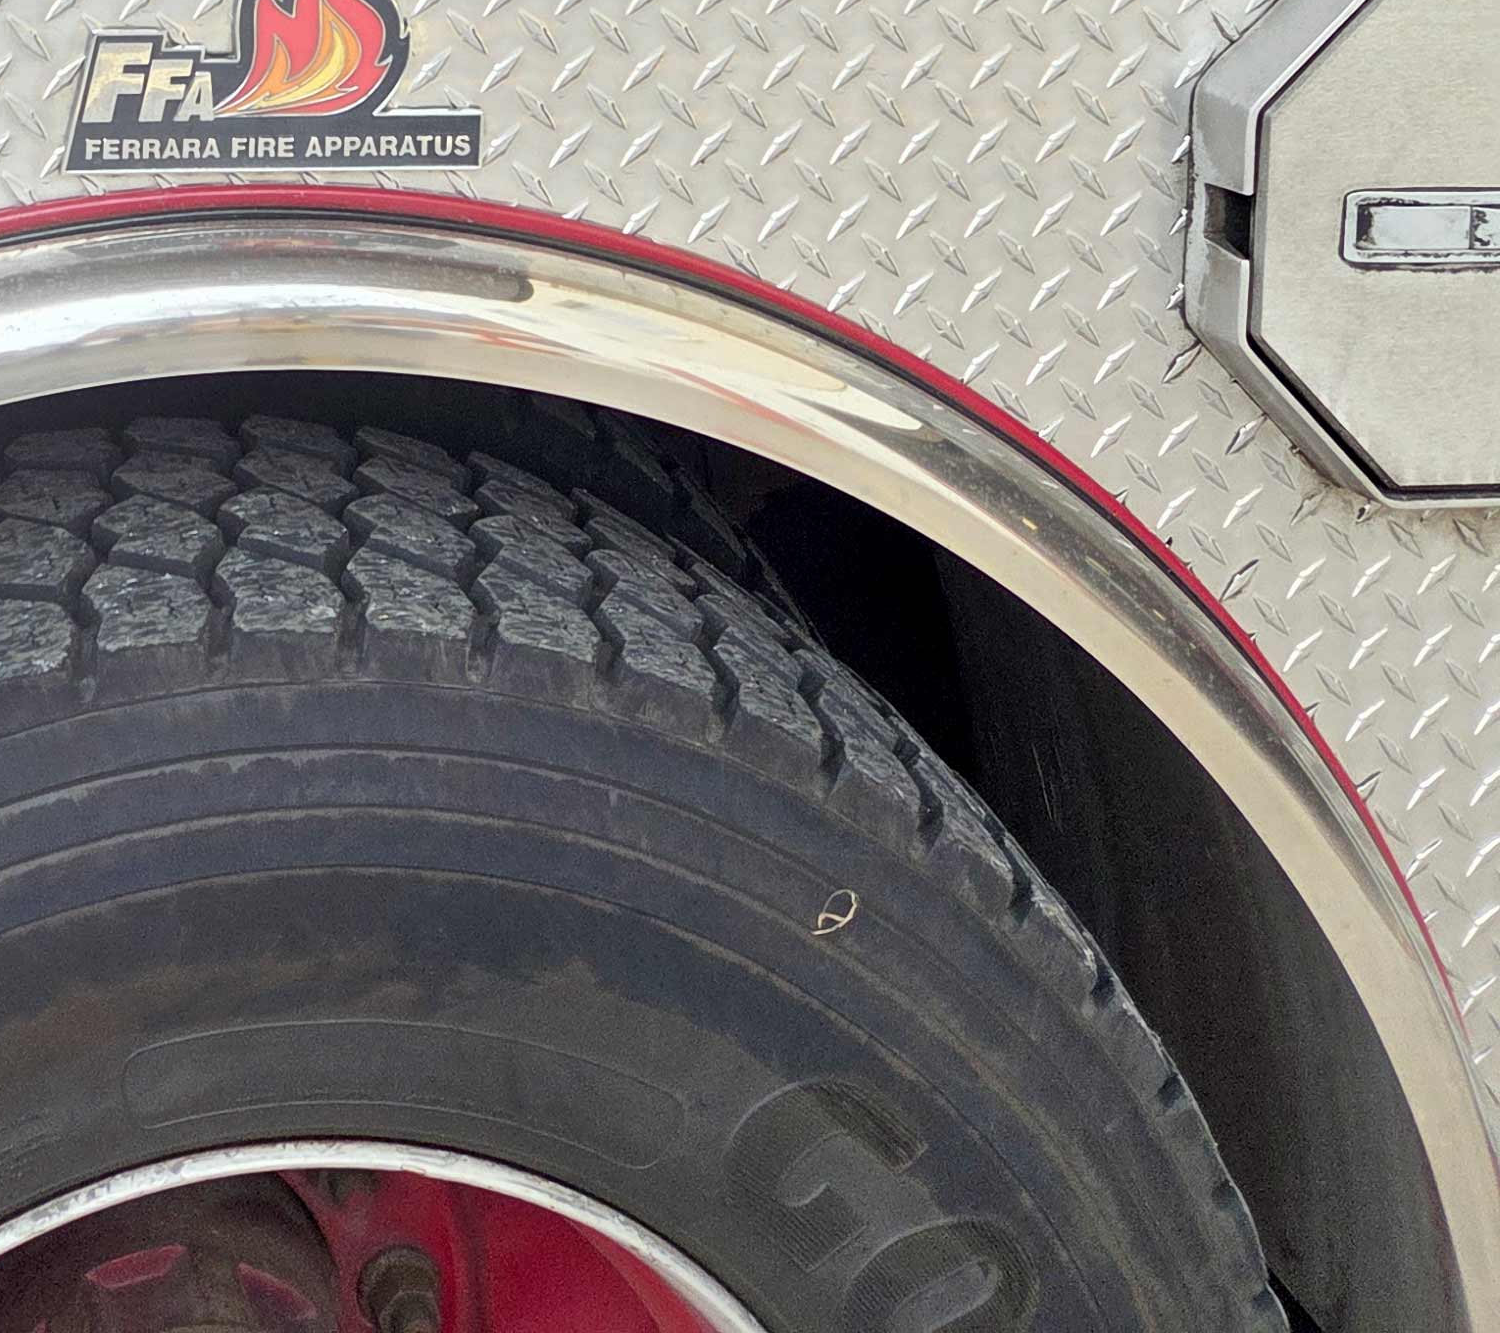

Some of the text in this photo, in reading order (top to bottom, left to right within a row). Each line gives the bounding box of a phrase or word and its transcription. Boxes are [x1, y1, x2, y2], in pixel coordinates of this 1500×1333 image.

[85, 134, 471, 161] FERRARA FIRE APPARATUS
